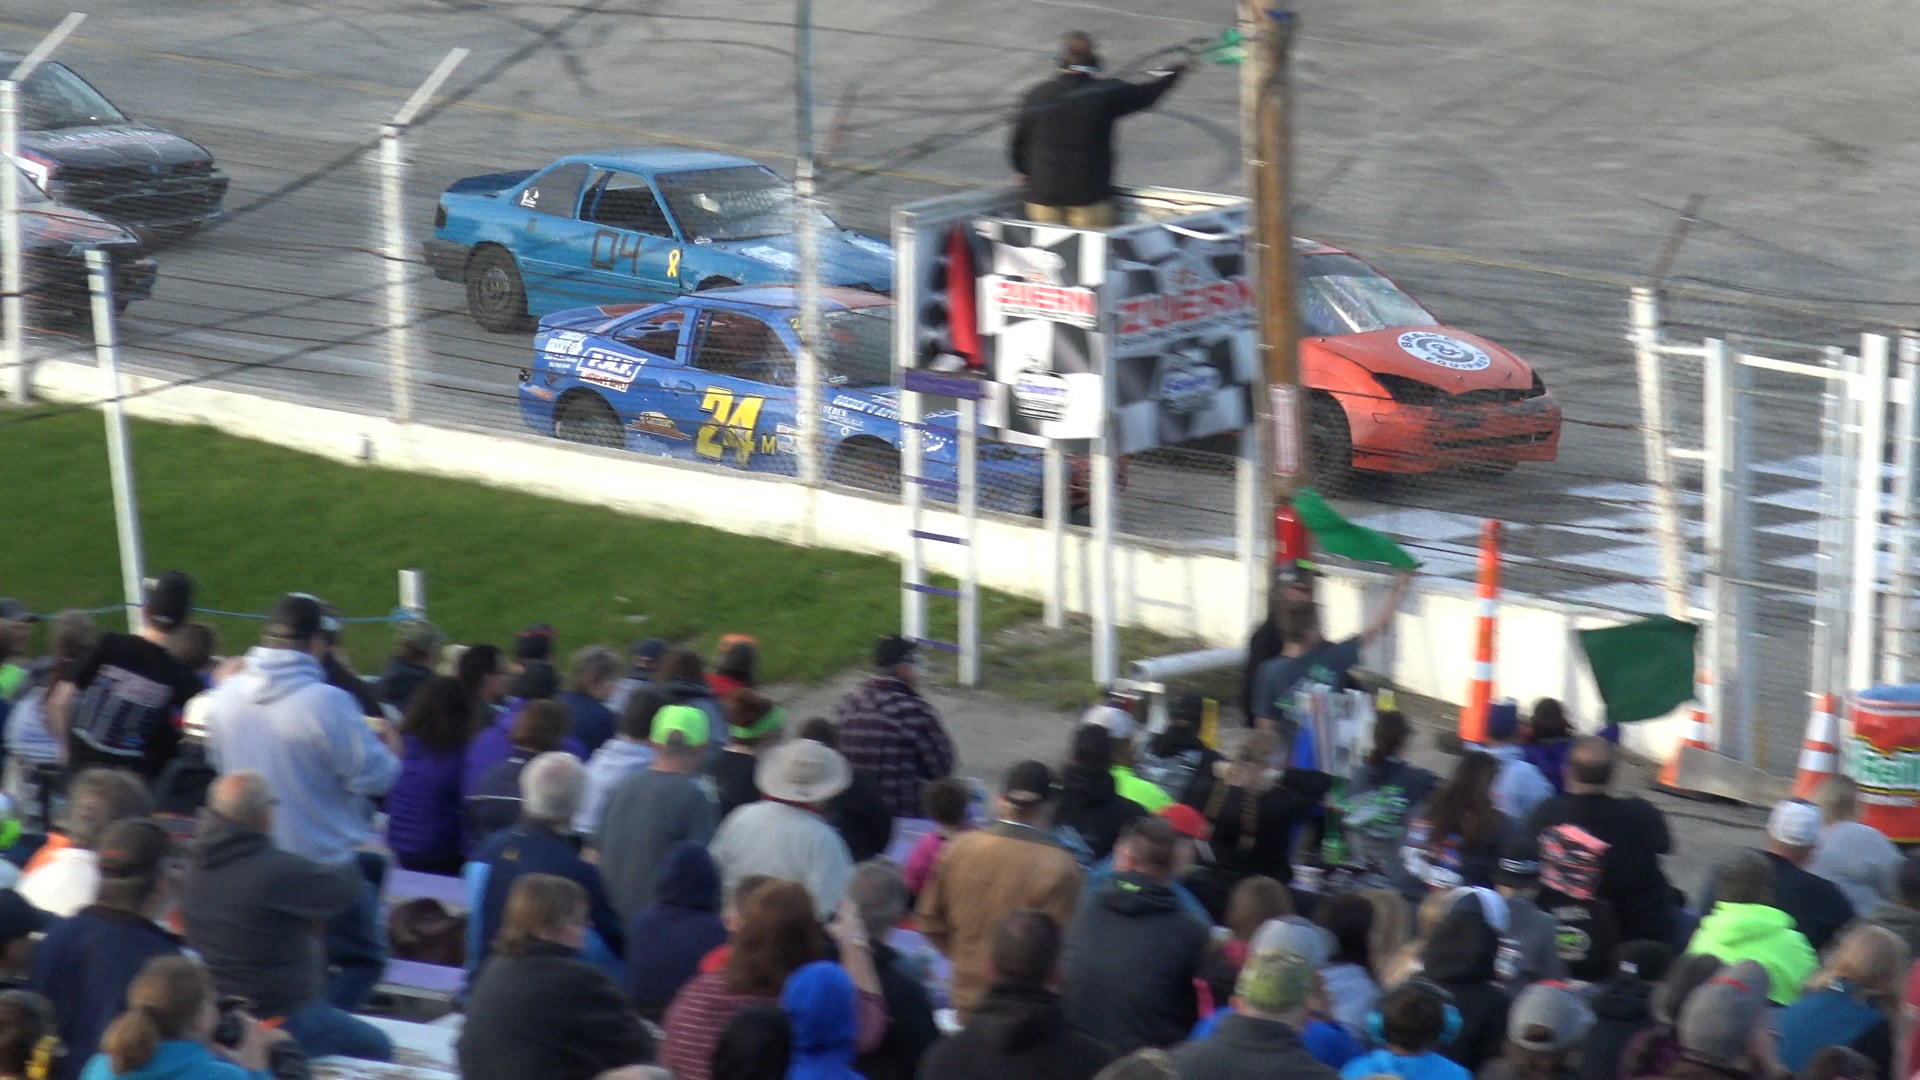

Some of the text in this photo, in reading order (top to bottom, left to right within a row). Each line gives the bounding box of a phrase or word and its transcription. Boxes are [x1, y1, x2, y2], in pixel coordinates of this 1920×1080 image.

[591, 228, 644, 277] 04
[696, 385, 765, 464] 24
[761, 434, 777, 455] M
